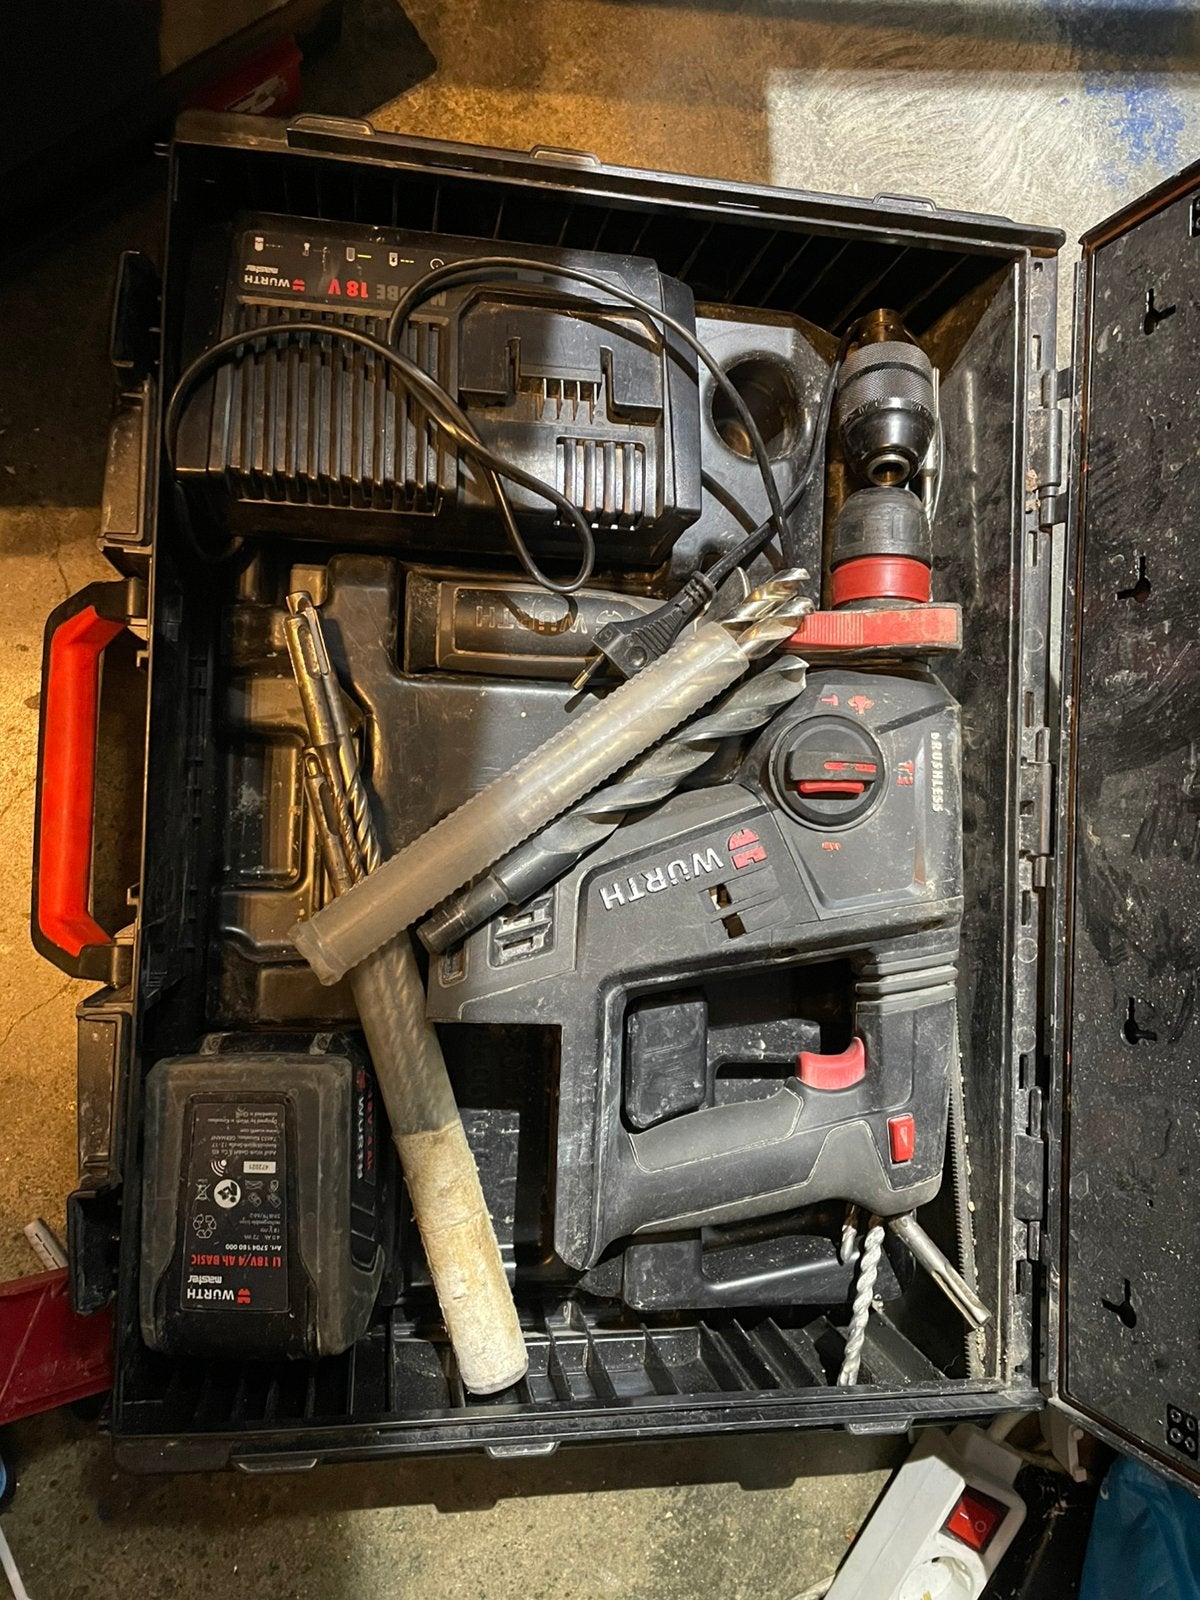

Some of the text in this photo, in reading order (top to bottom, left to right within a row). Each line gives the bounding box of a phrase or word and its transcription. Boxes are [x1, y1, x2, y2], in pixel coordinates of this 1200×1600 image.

[327, 278, 342, 296] V
[347, 280, 369, 300] 18
[475, 605, 588, 635] WÜRTH
[598, 847, 725, 912] WÜRTH
[191, 1253, 282, 1267] LI 18V/4 Ah BASIC
[187, 1275, 222, 1285] master
[187, 1288, 235, 1301] WÜRTH
